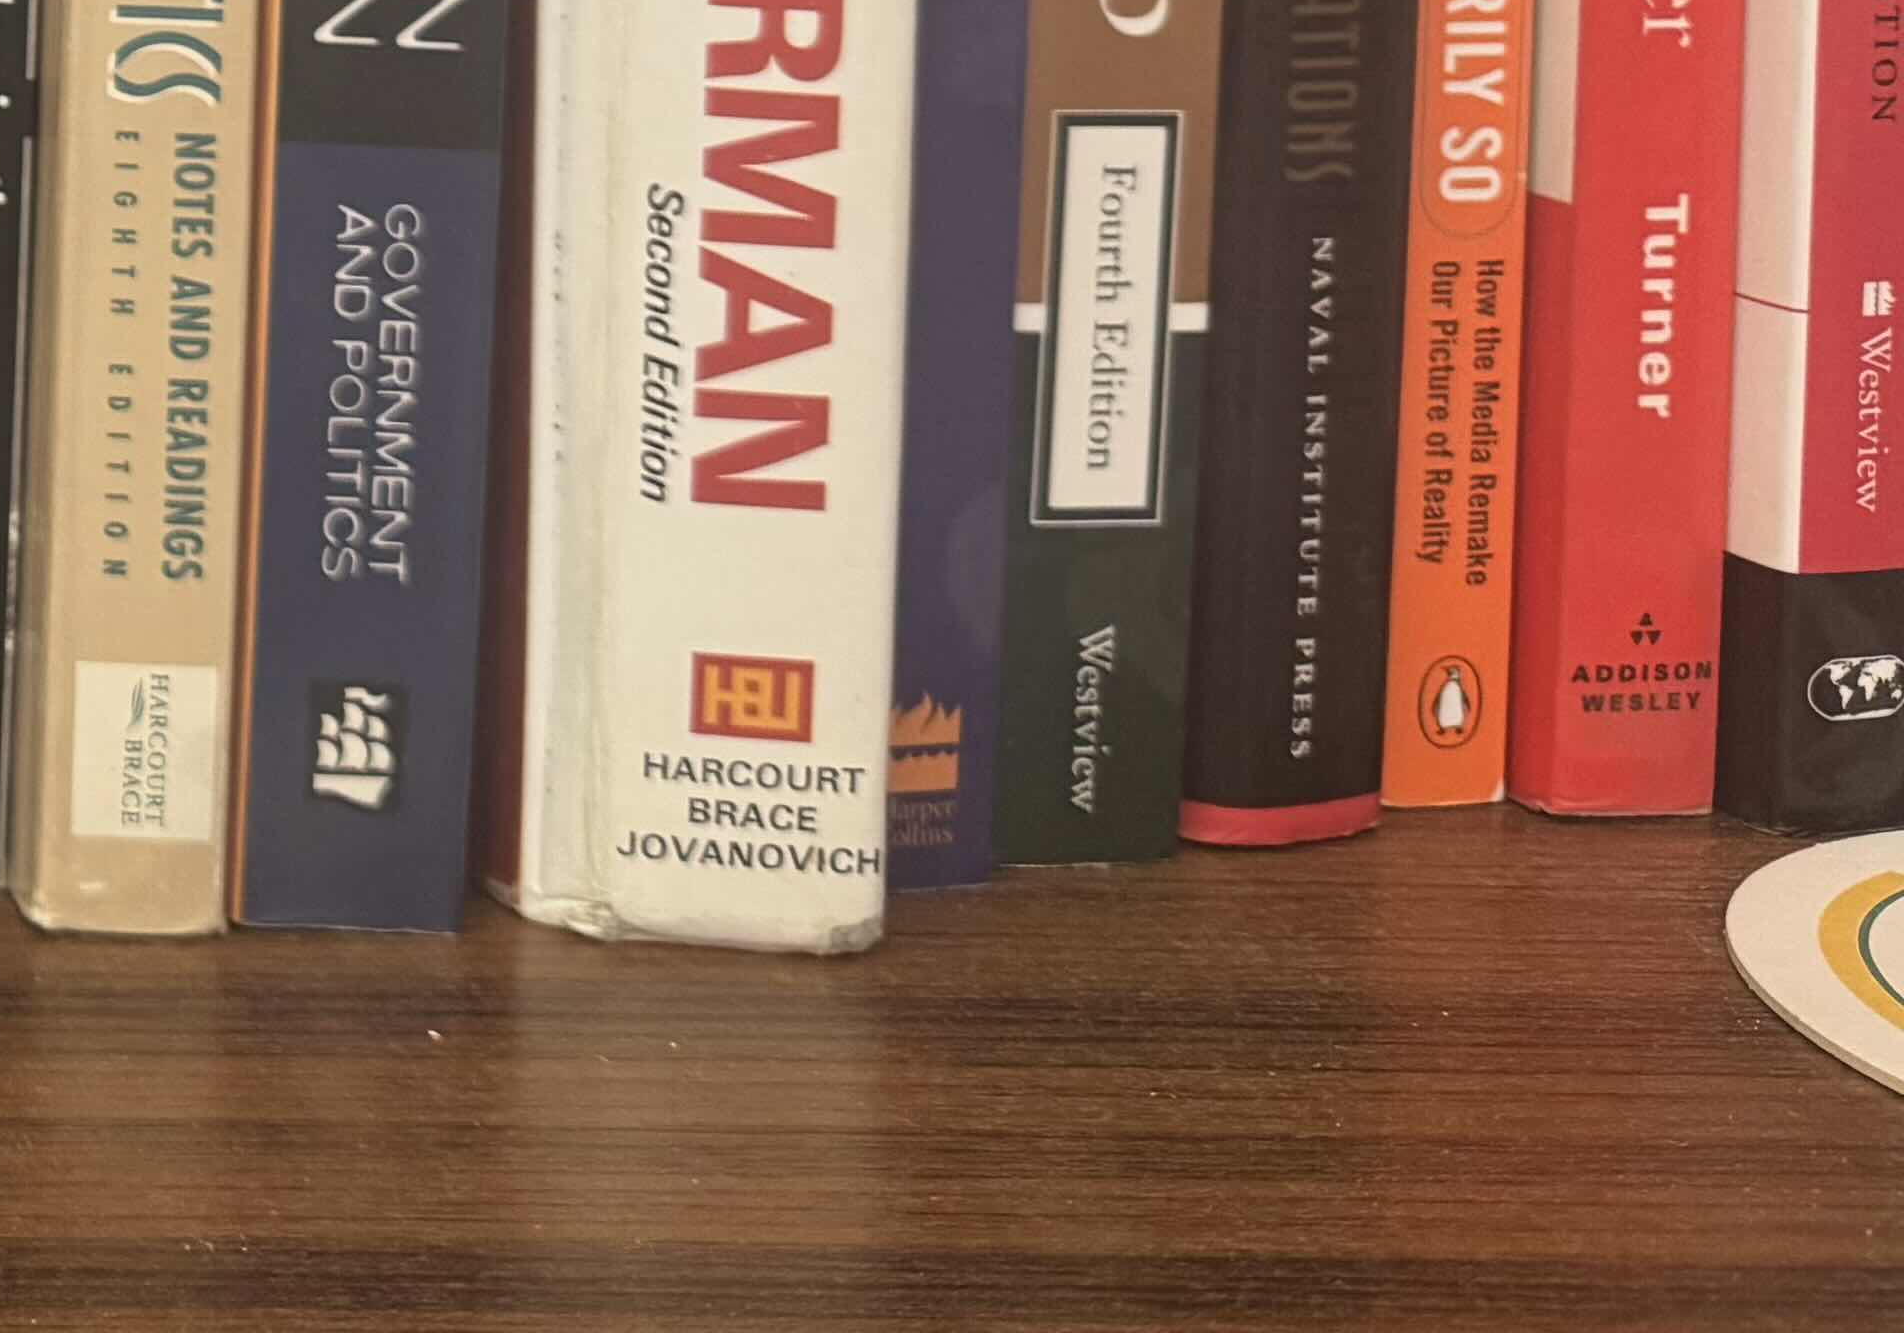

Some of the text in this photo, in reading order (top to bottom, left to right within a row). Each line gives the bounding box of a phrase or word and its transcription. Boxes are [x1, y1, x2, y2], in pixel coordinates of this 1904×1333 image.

[1437, 125, 1506, 205] SO
[160, 132, 217, 582] NOTES AND READINGS
[320, 203, 374, 583] AND POLITICS
[368, 203, 424, 585] GOVERNMENT
[638, 183, 687, 505] Second Edition
[1085, 164, 1139, 472] Fourth Edition
[1636, 192, 1689, 419] Turner
[101, 363, 134, 580] EDITION
[1289, 235, 1337, 762] NAVAL INSTITUTE PRESS
[1415, 260, 1461, 565] Our Picture of Reality
[1464, 259, 1506, 587] How the Media Remake
[1855, 327, 1893, 514] Westview
[143, 672, 171, 829] HARCOURT
[642, 750, 867, 795] HARCOURT
[1070, 623, 1118, 814] Westview
[1570, 660, 1714, 685] ADDISON
[1581, 691, 1703, 713] WESLEY
[120, 738, 144, 827] BRACE
[615, 828, 883, 877] JOVANOVICH
[686, 797, 820, 835] BRACE
